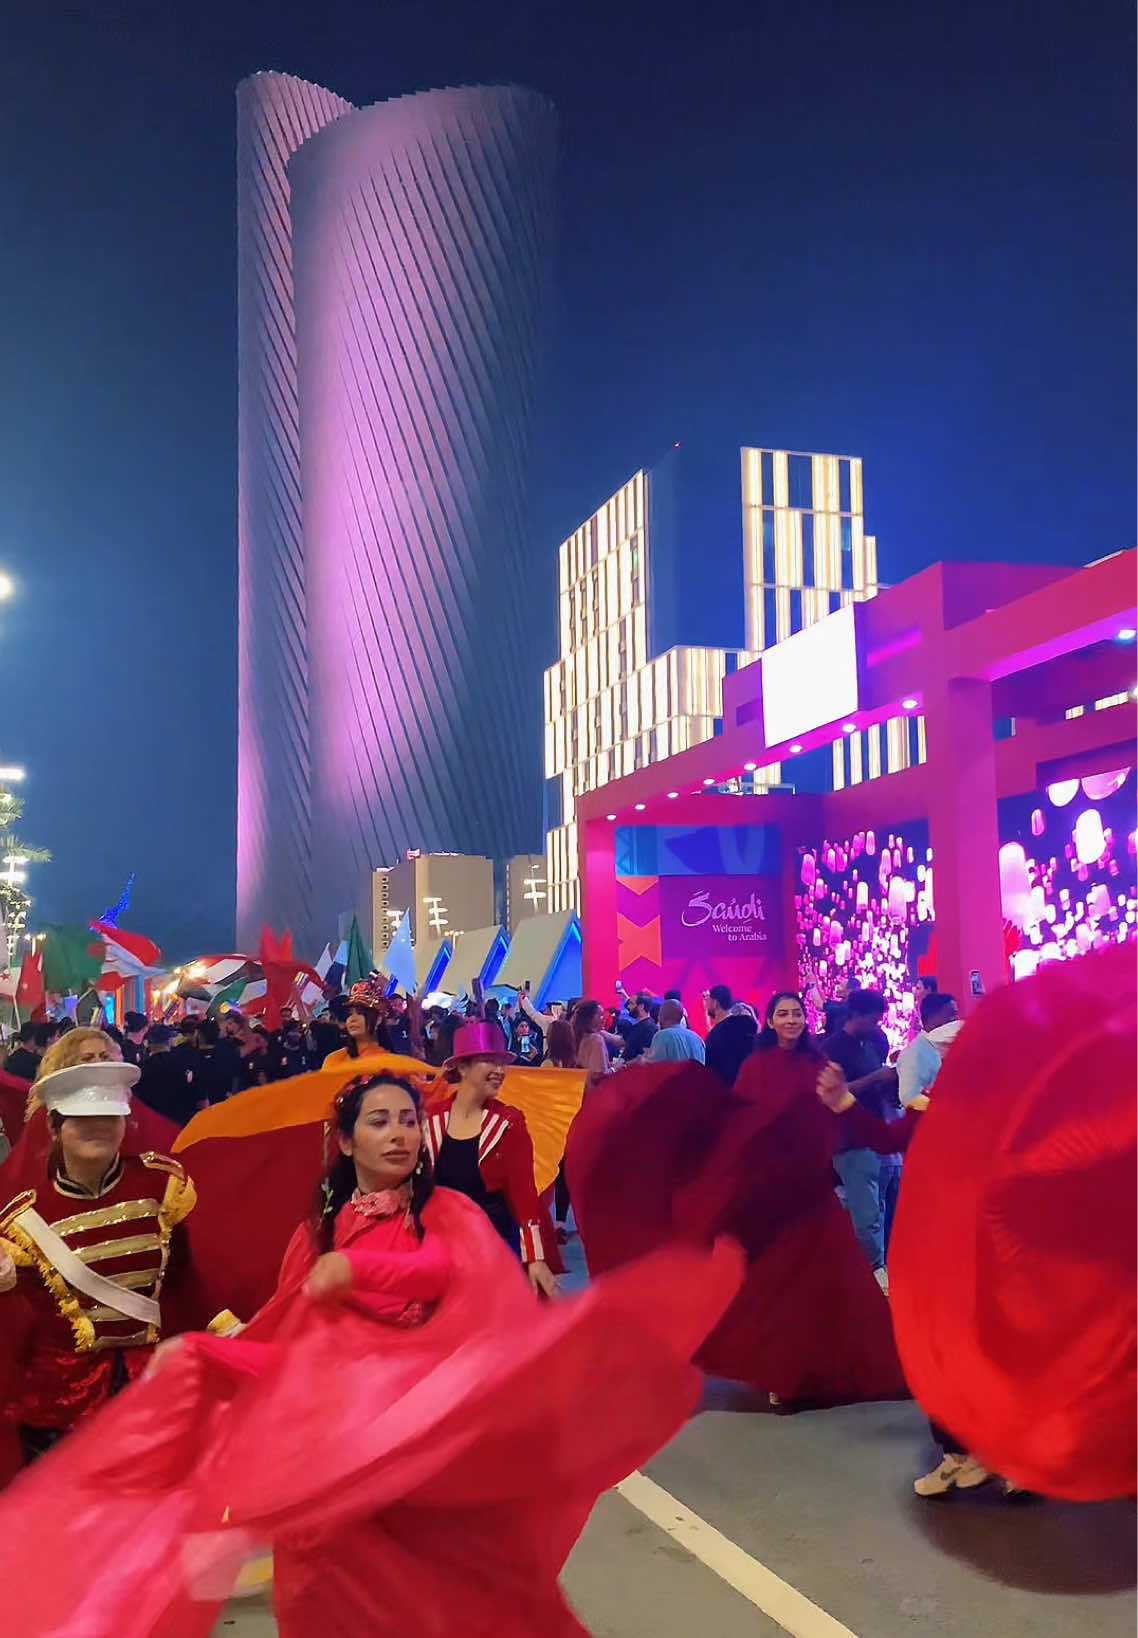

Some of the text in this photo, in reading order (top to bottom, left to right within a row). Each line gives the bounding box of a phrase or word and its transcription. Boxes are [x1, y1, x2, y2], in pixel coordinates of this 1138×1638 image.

[712, 924, 752, 933] Welcome
[728, 931, 767, 942] to Arabia
